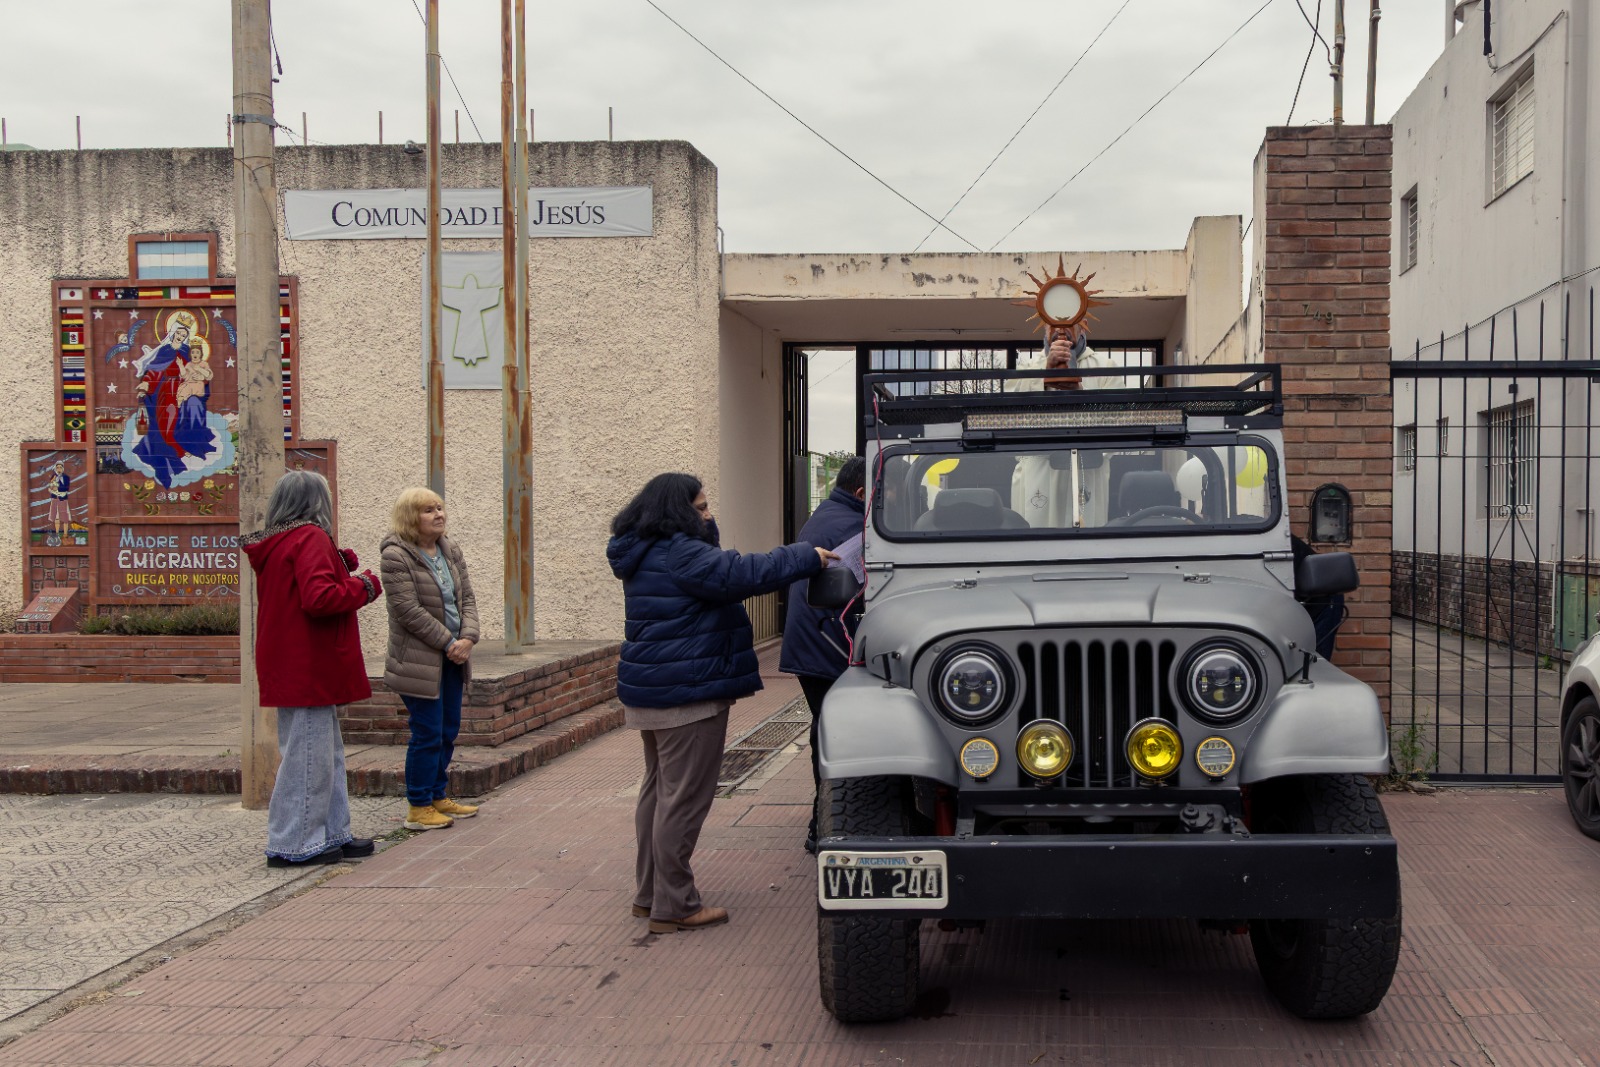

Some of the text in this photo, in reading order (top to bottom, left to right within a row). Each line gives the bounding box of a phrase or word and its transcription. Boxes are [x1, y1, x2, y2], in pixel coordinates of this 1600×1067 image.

[331, 201, 487, 227] COMUNDAD
[532, 200, 605, 225] JESÚS
[1302, 304, 1334, 325] 749
[119, 526, 238, 548] MADRE DE LOS
[126, 573, 239, 585] RUEGA POR NOSOTROS
[859, 858, 907, 866] ARGENTINA
[827, 868, 938, 898] VYA 244
